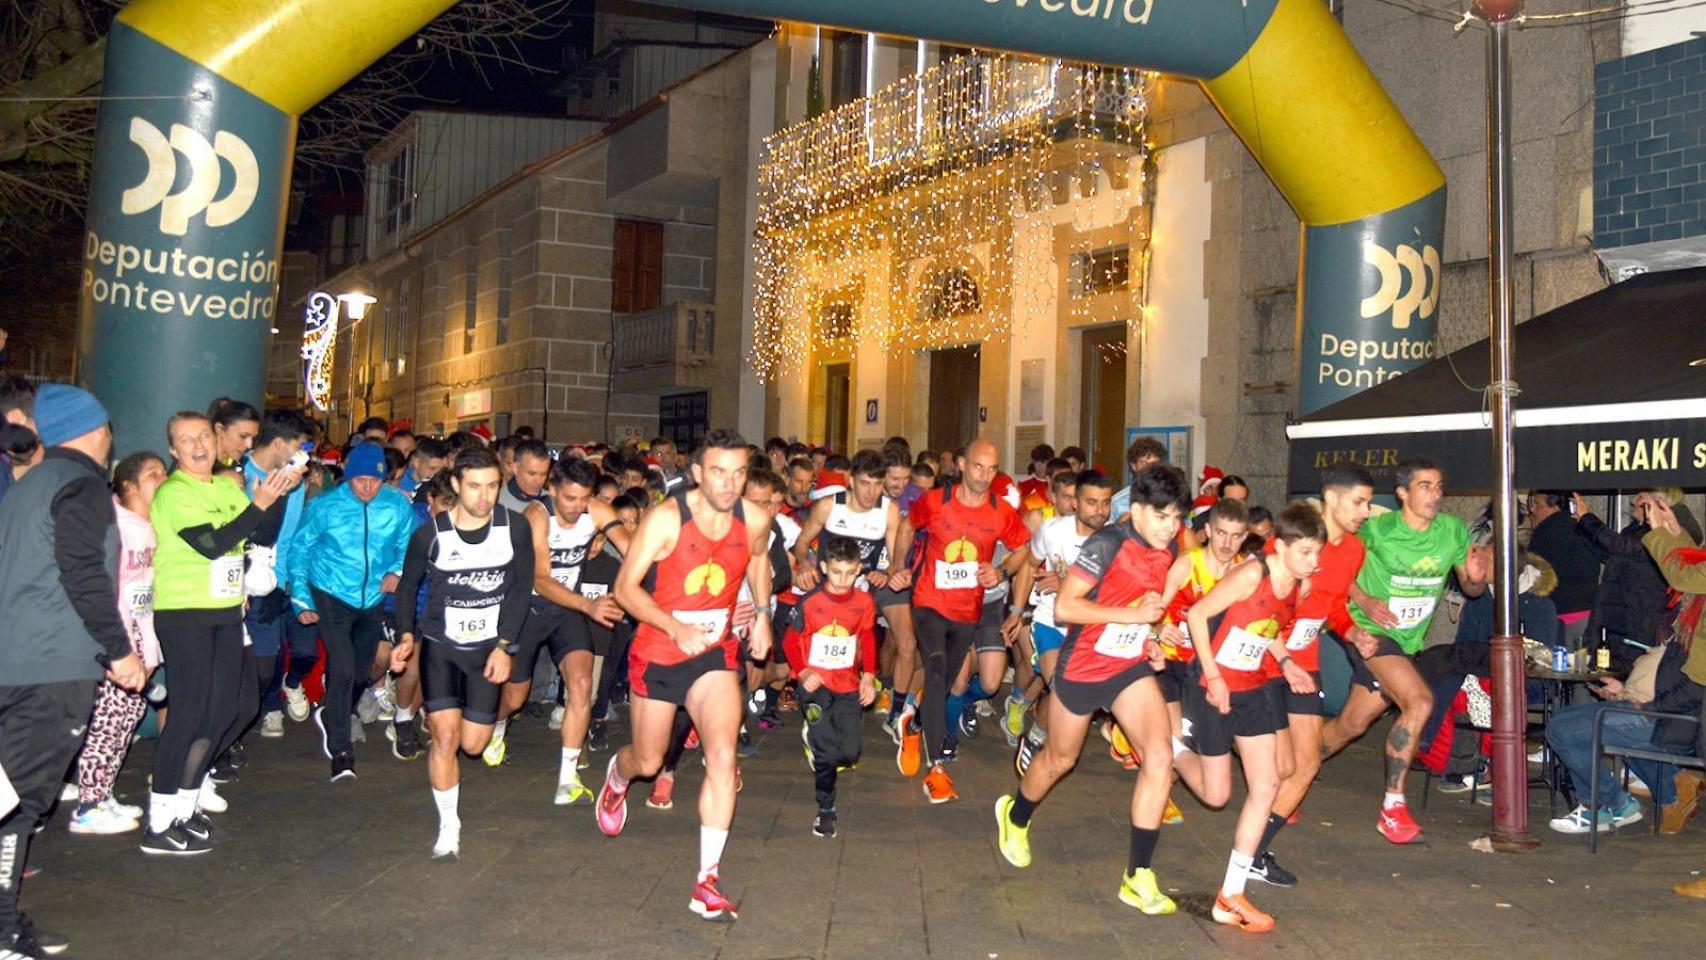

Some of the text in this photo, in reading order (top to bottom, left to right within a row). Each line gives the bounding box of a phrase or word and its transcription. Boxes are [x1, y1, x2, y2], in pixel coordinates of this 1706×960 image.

[86, 231, 277, 283] Deputación
[82, 269, 274, 320] Pontevedra
[1577, 437, 1679, 472] MERAKI
[227, 568, 241, 582] 87
[945, 569, 968, 580] 190
[1400, 607, 1422, 619] 131
[459, 619, 486, 632] 163
[1115, 632, 1138, 644] 119
[824, 644, 847, 657] 184
